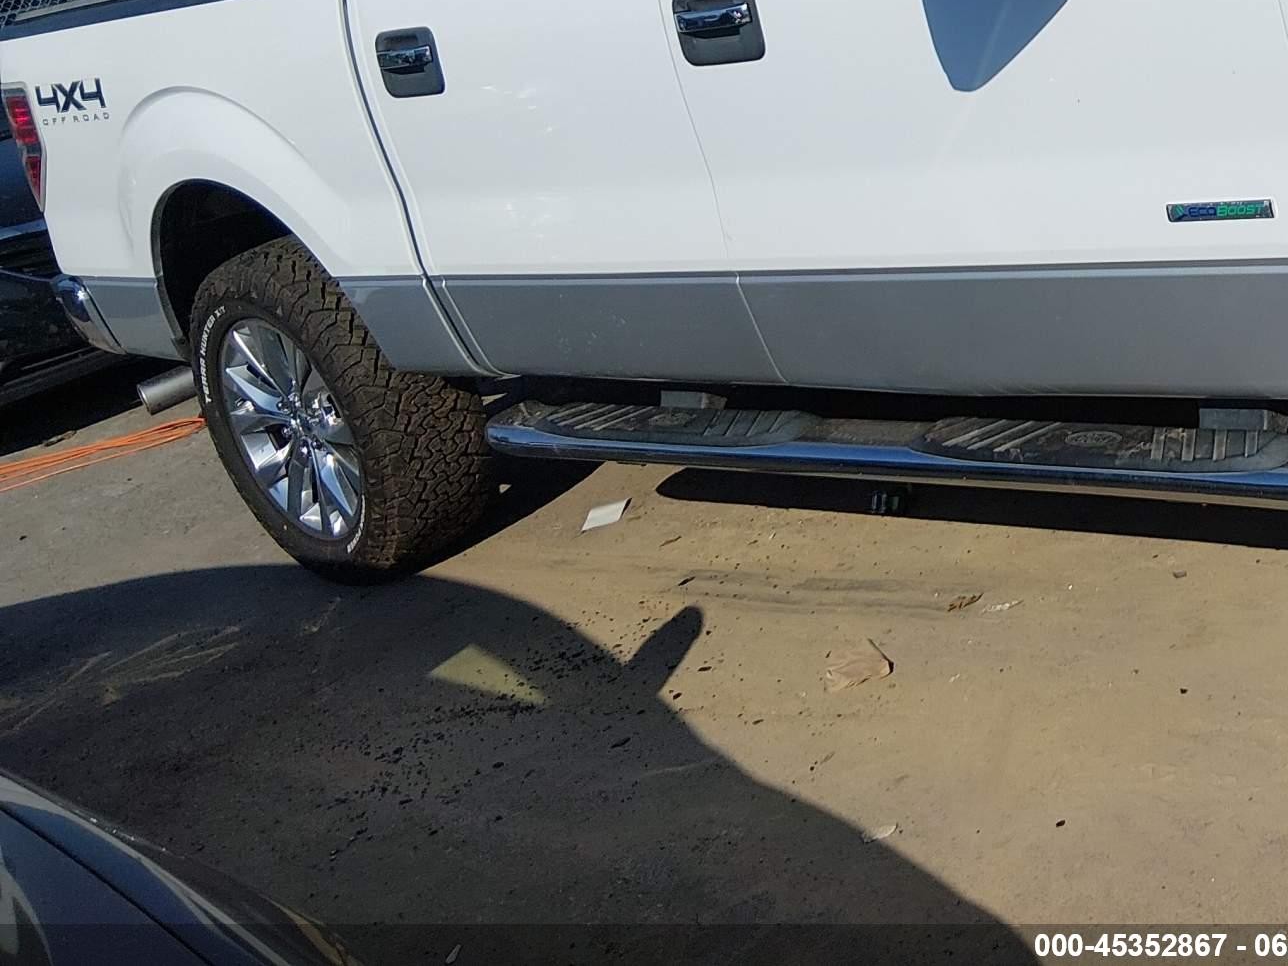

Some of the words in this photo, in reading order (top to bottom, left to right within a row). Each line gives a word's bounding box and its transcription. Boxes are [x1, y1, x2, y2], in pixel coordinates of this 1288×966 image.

[35, 78, 107, 113] 4X4
[42, 116, 68, 126] OFF
[73, 112, 110, 123] ROAD
